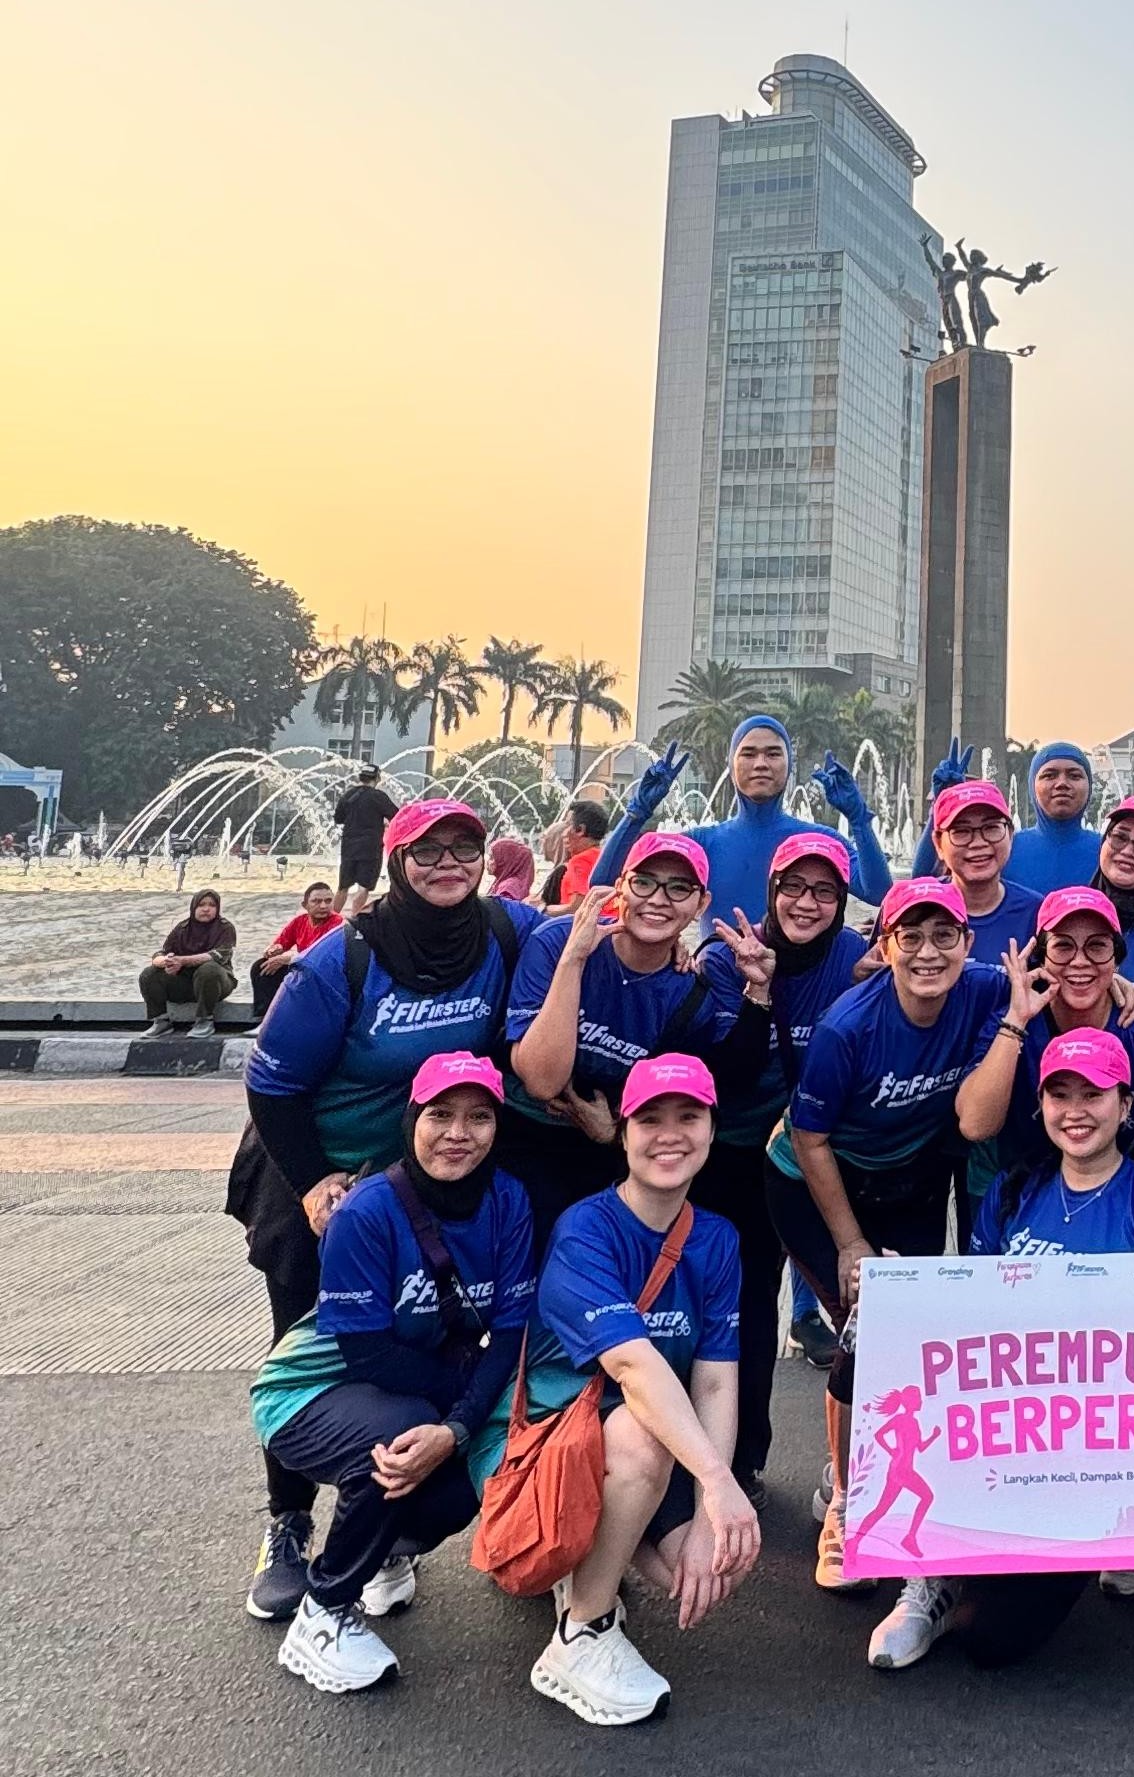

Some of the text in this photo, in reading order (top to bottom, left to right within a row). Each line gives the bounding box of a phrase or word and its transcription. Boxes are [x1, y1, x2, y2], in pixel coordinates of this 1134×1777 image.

[1003, 1474, 1048, 1486] Langkah
[1051, 1472, 1078, 1484] Kecil,
[1080, 1471, 1124, 1483] Dampak
